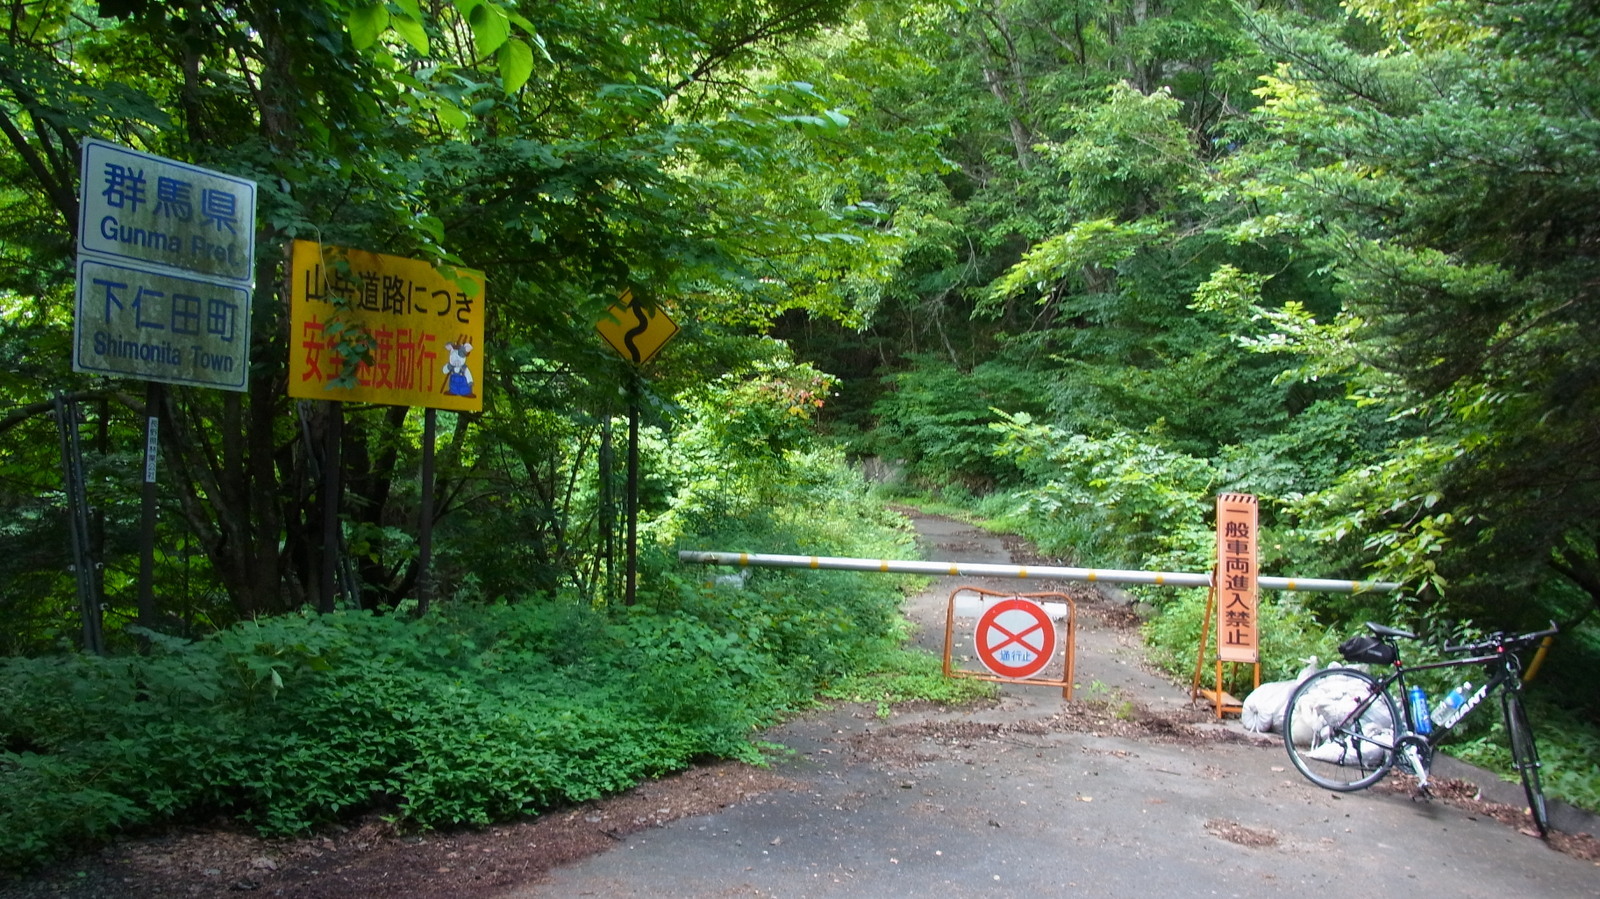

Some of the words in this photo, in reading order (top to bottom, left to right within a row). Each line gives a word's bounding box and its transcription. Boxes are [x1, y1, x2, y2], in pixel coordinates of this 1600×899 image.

[102, 162, 238, 235] 群馬県
[101, 215, 182, 253] Gunma
[93, 278, 239, 342] 下仁田町
[93, 331, 182, 366] Shimonita
[191, 345, 233, 373] Town
[1225, 508, 1250, 646] 一般車両進入禁止
[1000, 650, 1031, 662] 通行止
[1445, 684, 1488, 729] GIANT
